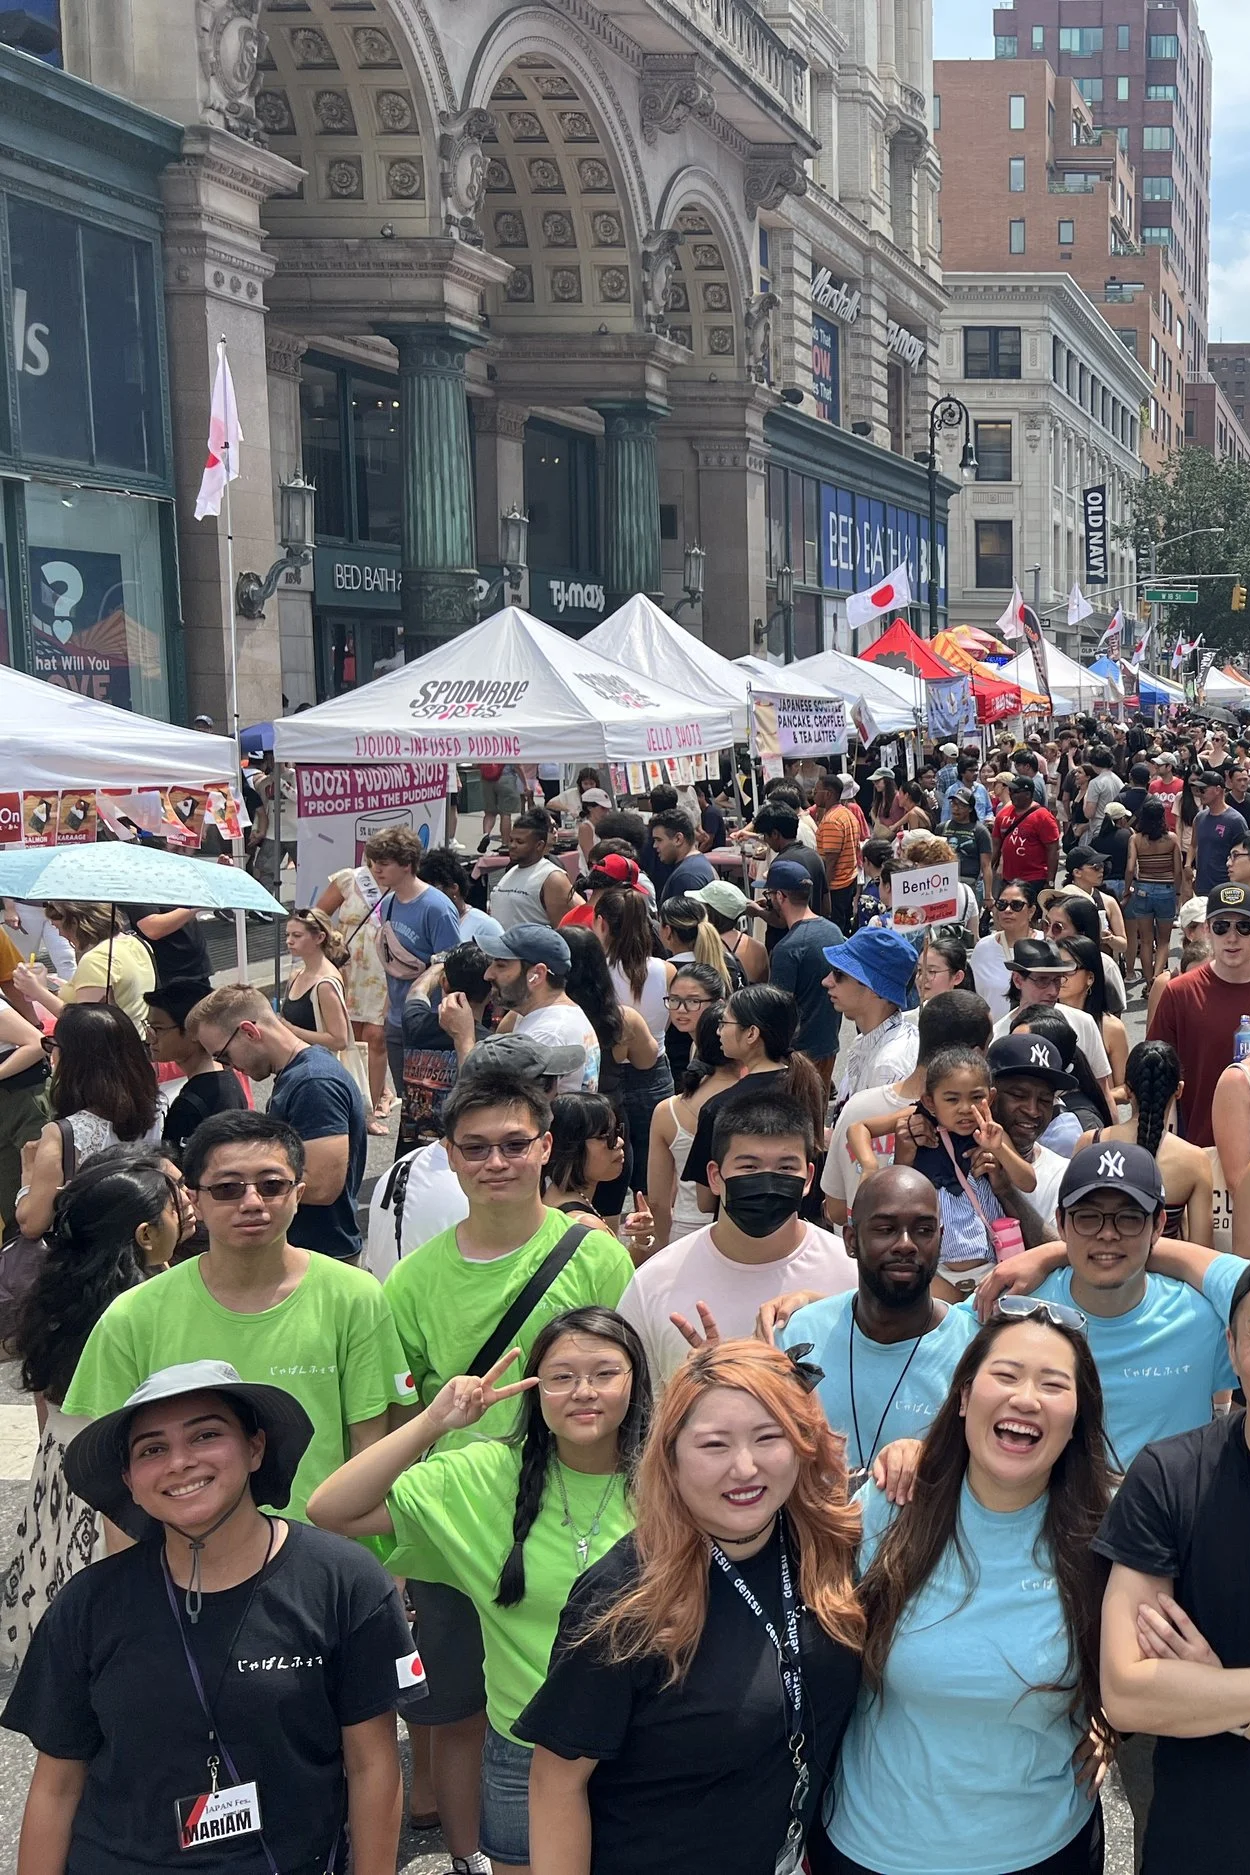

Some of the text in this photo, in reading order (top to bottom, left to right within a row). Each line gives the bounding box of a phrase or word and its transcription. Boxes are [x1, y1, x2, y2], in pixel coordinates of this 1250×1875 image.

[811, 267, 861, 324] Marshalls
[812, 344, 831, 382] OW.
[829, 511, 860, 570] BED
[864, 522, 901, 577] BATH
[1087, 492, 1104, 578] OLD NAVY
[336, 563, 397, 593] BED BATH
[35, 656, 110, 671] hat Will You
[47, 673, 111, 700] OVE
[409, 680, 529, 709] SPOONABLE
[778, 699, 813, 712] JAPANESE
[778, 715, 845, 729] PANCAKE, CROFFLES
[468, 735, 521, 756] PUDDING
[647, 723, 703, 751] JELLO SHOTS
[792, 730, 837, 744] & TEA LATTES
[301, 763, 444, 798] BOOZY PUDDING SHOTS
[0, 807, 20, 824] On
[355, 797, 364, 810] IS
[367, 796, 379, 809] IN
[381, 793, 400, 806] THE
[902, 874, 949, 895] BentOn
[1030, 1043, 1050, 1068] NY
[1097, 1150, 1125, 1178] NY
[780, 1554, 793, 1599] dentsu
[734, 1578, 763, 1616] dentsu
[205, 1800, 233, 1815] JAPAN
[235, 1798, 252, 1807] Fes.
[182, 1811, 252, 1847] MARIAM
